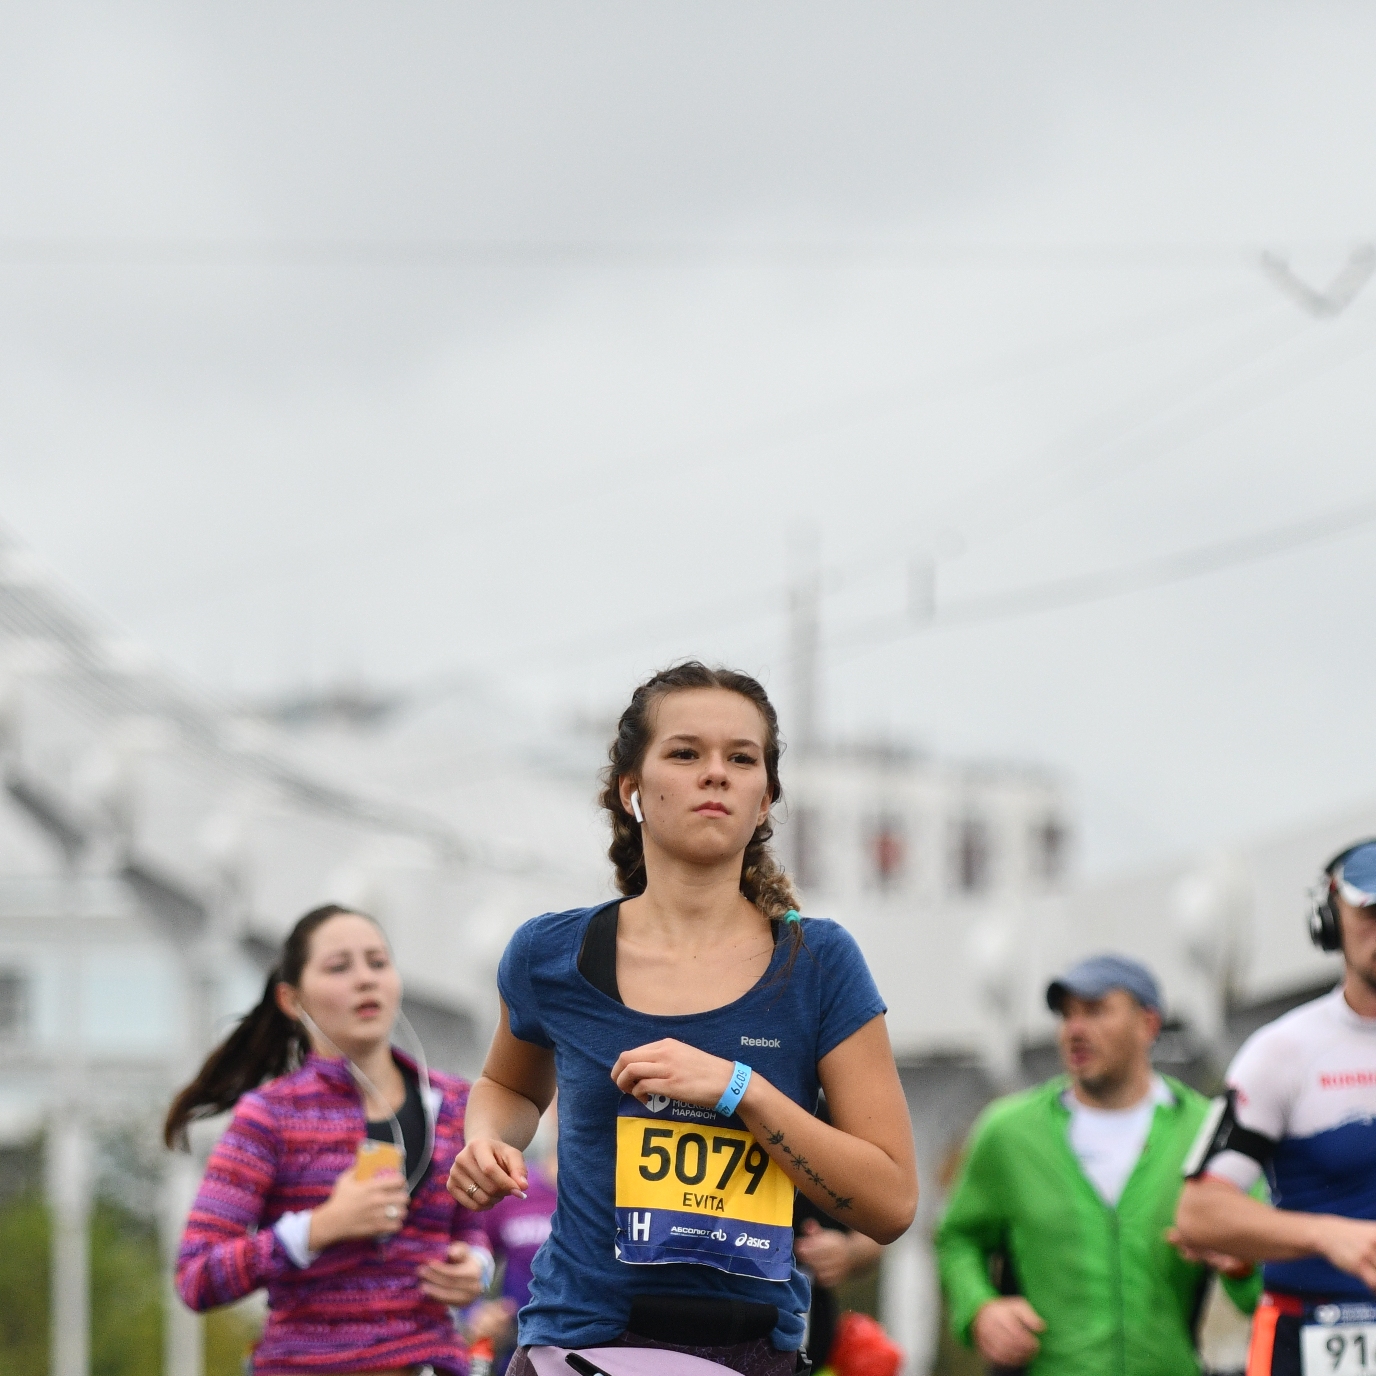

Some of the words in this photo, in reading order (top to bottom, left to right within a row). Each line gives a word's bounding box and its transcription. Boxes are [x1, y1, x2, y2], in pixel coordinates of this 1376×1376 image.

[740, 1035, 782, 1049] Reebok
[731, 1069, 747, 1096] 5079
[672, 1108, 717, 1120] МАРАФОН
[638, 1126, 770, 1196] 5079
[682, 1191, 726, 1213] EVITA
[746, 1236, 771, 1250] asics
